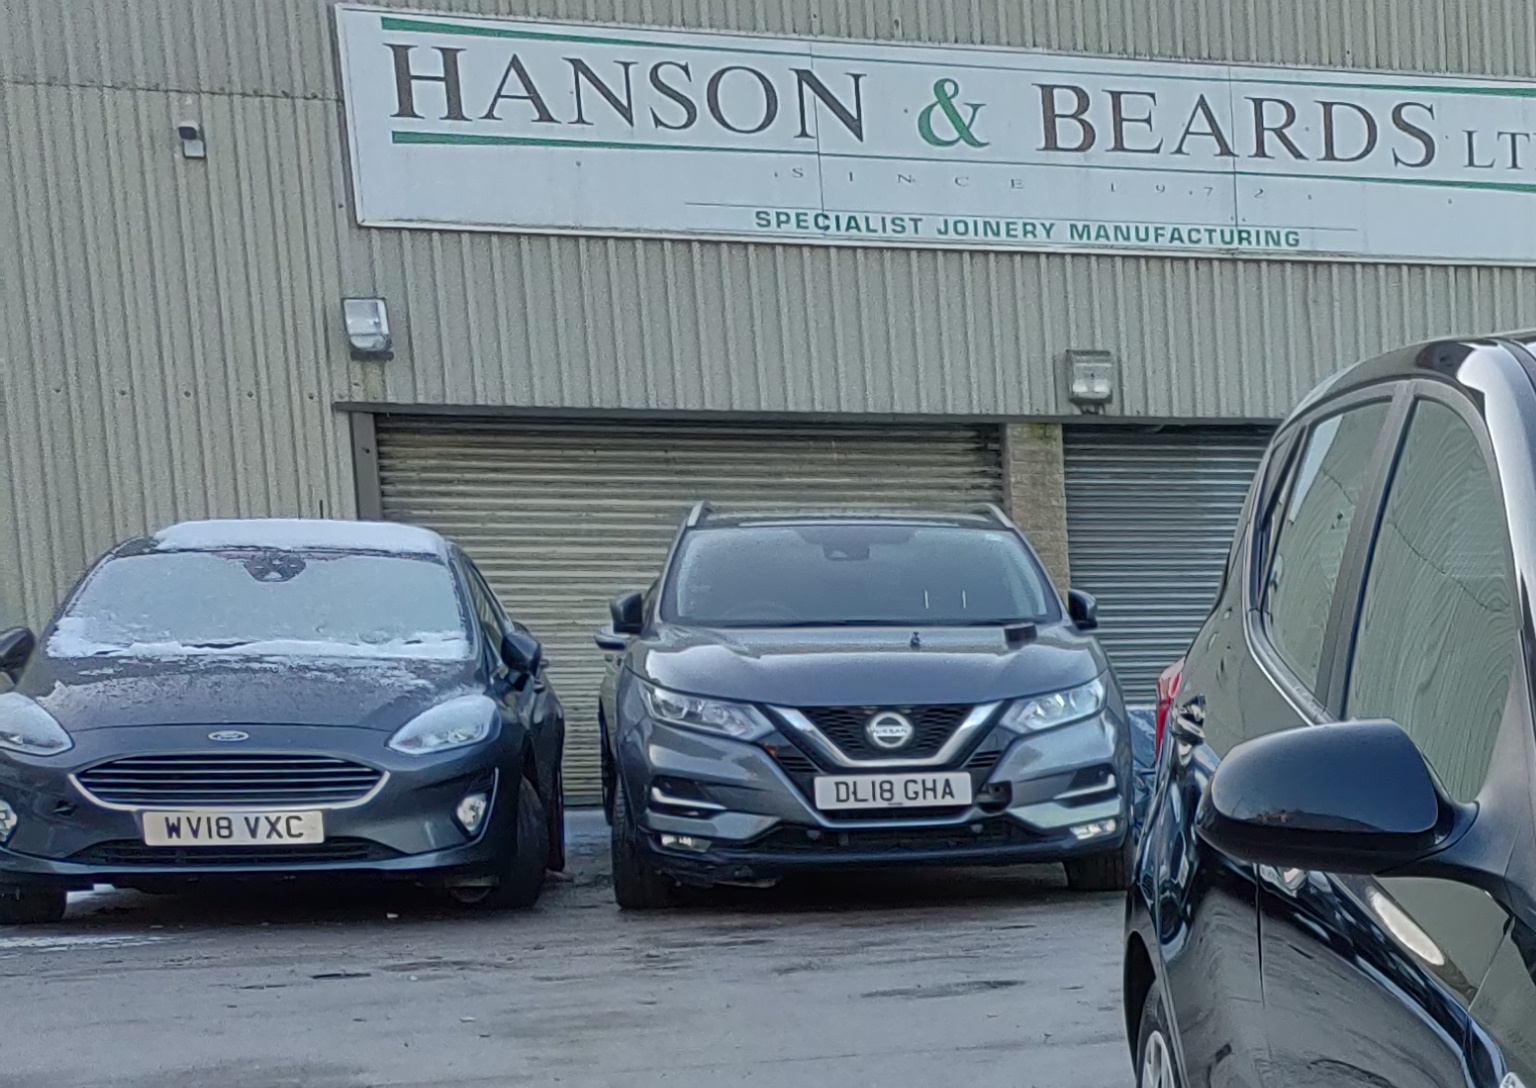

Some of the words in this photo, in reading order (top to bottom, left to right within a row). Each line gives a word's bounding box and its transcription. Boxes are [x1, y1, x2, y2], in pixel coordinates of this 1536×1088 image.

[383, 43, 867, 143] HANSON
[917, 78, 991, 149] &
[1031, 83, 1437, 169] BEARDS
[755, 210, 924, 235] SPECIALIST
[936, 218, 1058, 241] JOINERY
[1069, 223, 1301, 249] MANUFACTURING
[834, 780, 895, 803] DL18
[904, 778, 955, 800] GHA
[165, 816, 234, 840] WV18
[244, 815, 304, 839] VXC
